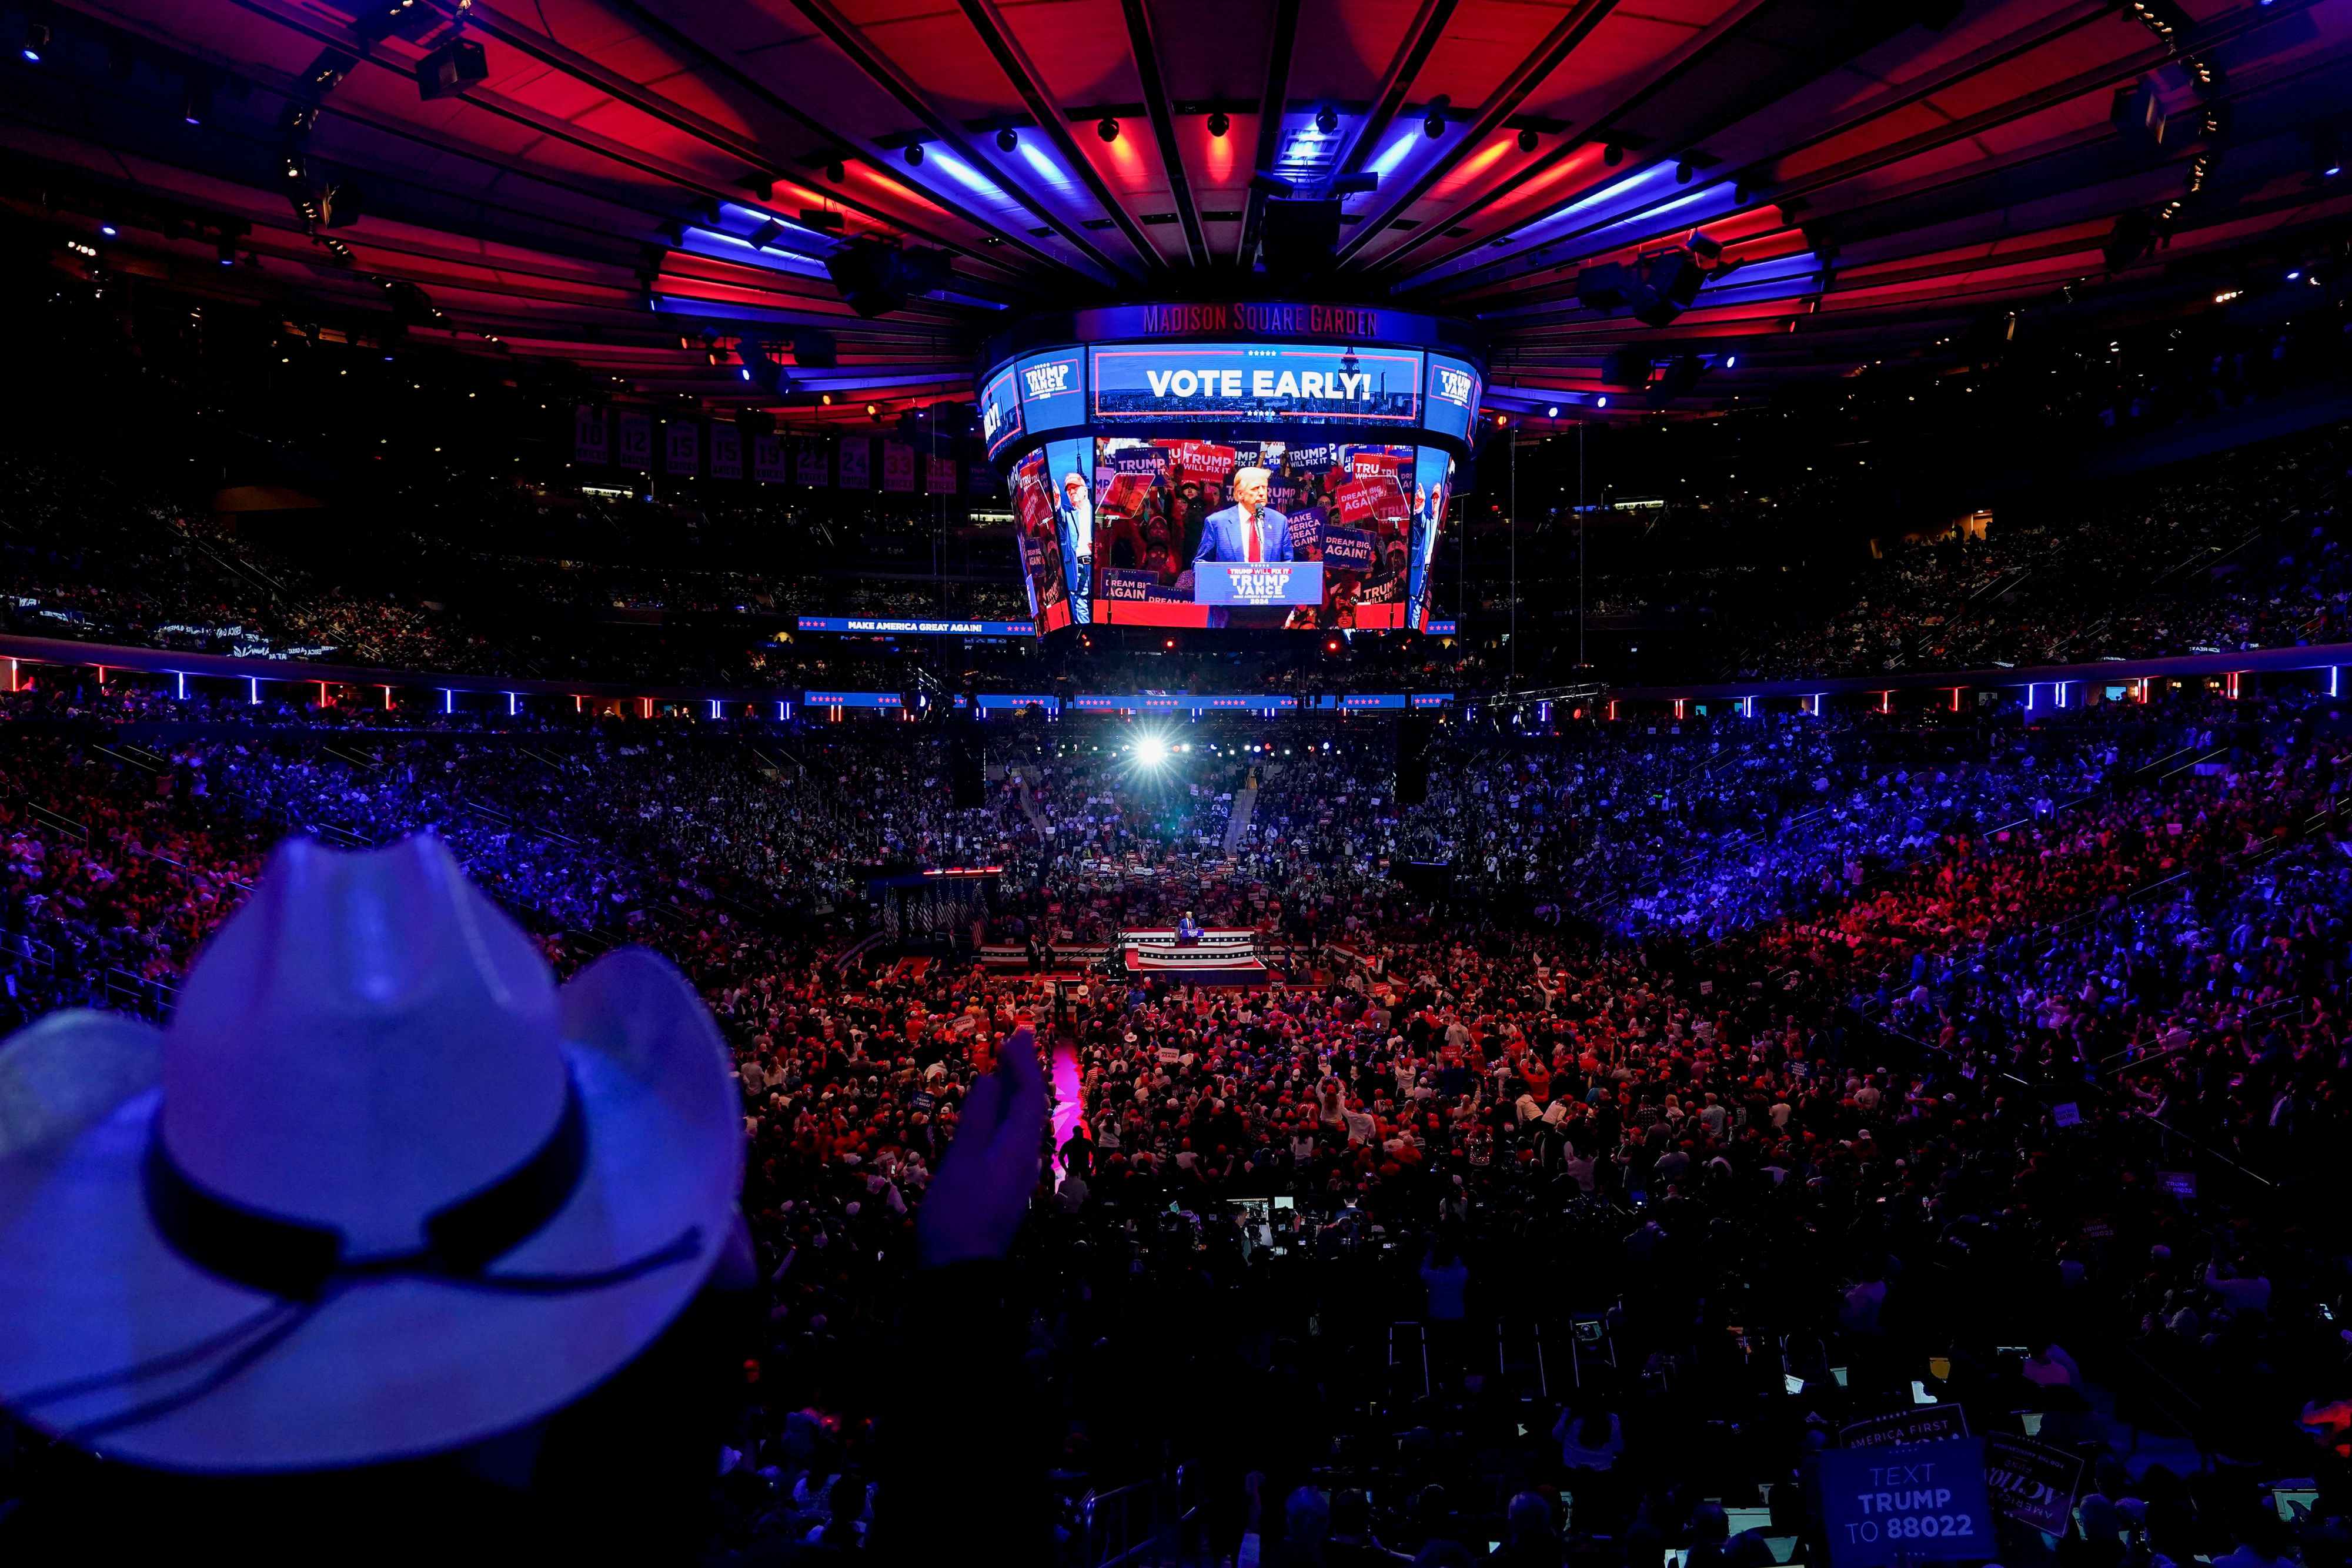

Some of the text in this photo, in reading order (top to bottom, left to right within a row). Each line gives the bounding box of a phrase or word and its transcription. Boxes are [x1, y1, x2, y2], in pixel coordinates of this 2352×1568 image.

[1143, 303, 1377, 336] MADISON SQUARE GARDEN
[1026, 365, 1068, 384] TRUMP
[1030, 377, 1063, 392] VANCE
[1147, 370, 1371, 400] VOTE EARLY!
[1185, 453, 1231, 467] TRUMP
[1289, 447, 1327, 461] TRUMP
[1118, 459, 1165, 470] TRUMP
[1183, 463, 1204, 472] WILL
[1355, 463, 1379, 473] TRU
[1267, 488, 1295, 498] RUMP
[1287, 513, 1312, 524] MAKE
[1288, 519, 1320, 532] MERICA
[1326, 537, 1371, 550] DREAM BIG,
[1325, 545, 1367, 559] AGAIN!
[1230, 574, 1289, 586] TRUMP
[1236, 586, 1282, 595] VANCE
[848, 621, 982, 632] MAKE AMERICA GREAT AGAIN!
[2083, 1225, 2107, 1233] TRUMP
[1851, 1429, 1905, 1449] AMERICA
[1910, 1420, 1948, 1435] FIRST
[2004, 1459, 2033, 1474] FUND
[1870, 1463, 1936, 1486] TEXT
[1858, 1489, 1951, 1514] TRUMP
[1845, 1514, 1973, 1544] TO 88022
